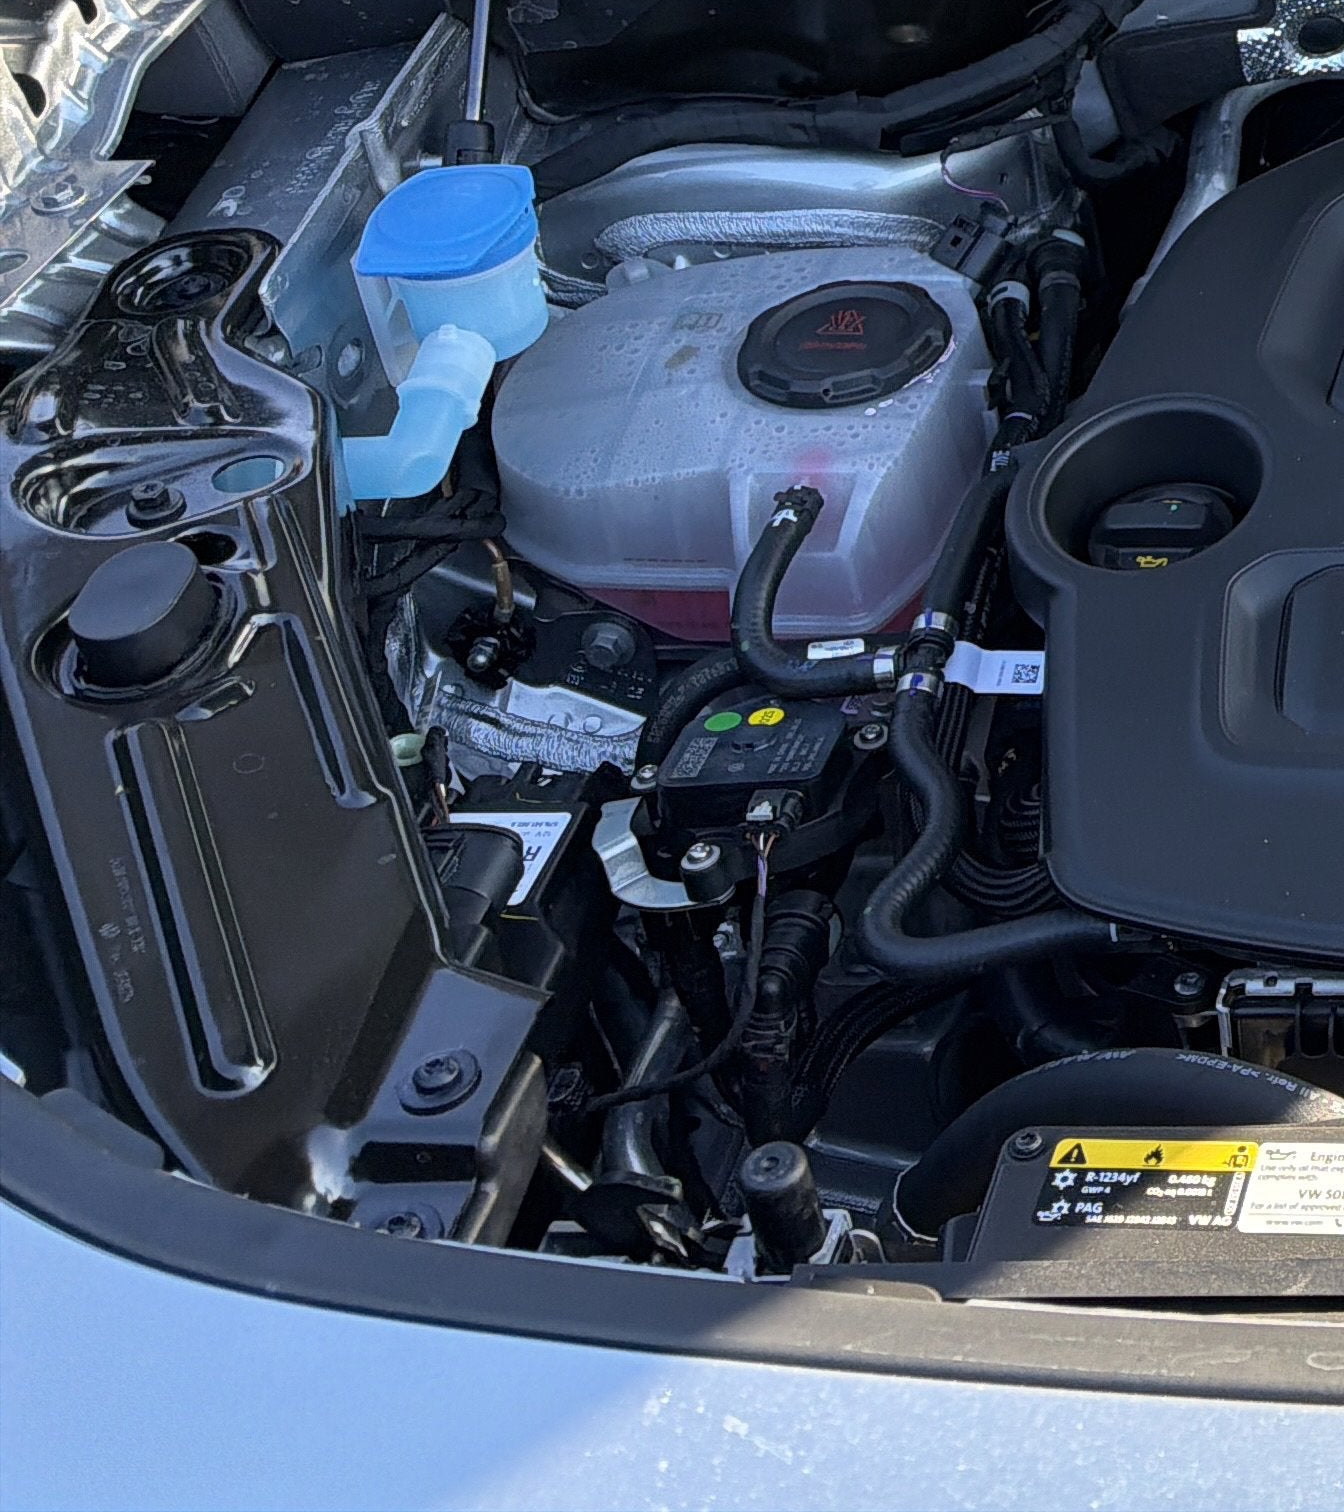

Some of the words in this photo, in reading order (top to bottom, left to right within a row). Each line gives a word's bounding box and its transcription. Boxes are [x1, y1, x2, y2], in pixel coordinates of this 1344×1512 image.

[1085, 1172, 1142, 1187] R-1234yf
[1298, 1189, 1322, 1200] VW
[1074, 1201, 1105, 1214] PAG
[1188, 1214, 1213, 1226] VW
[1210, 1215, 1234, 1227] AG
